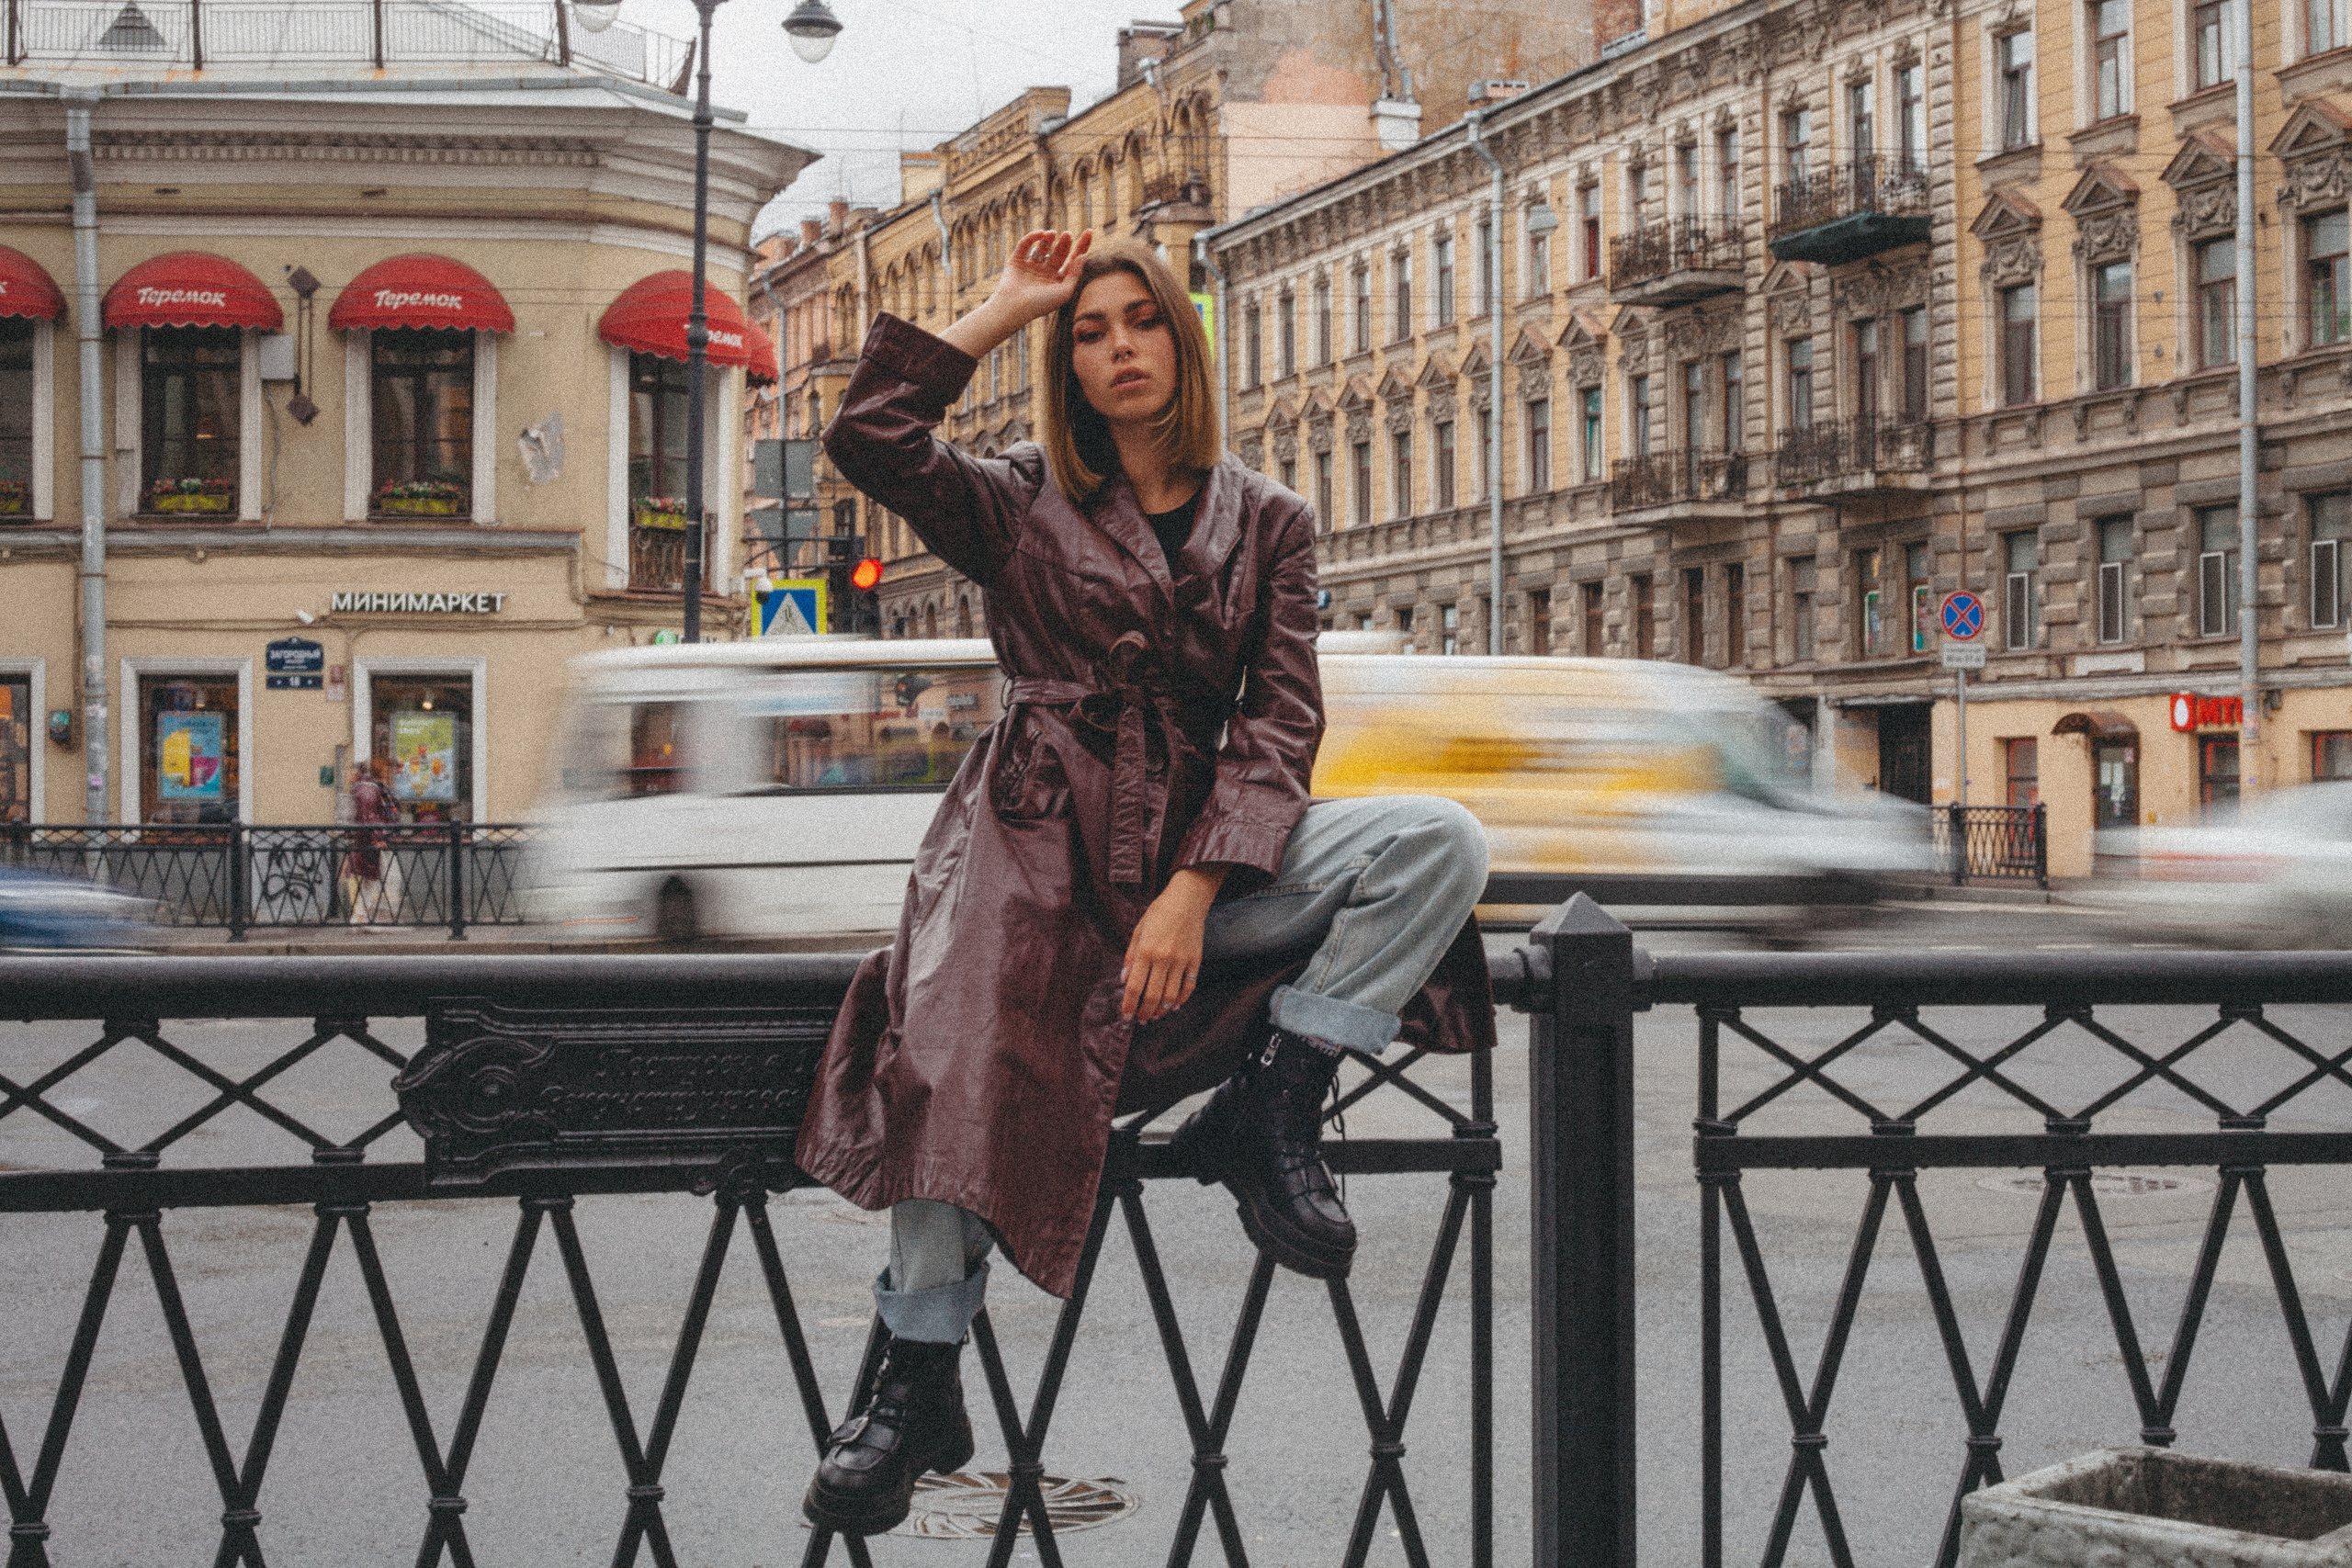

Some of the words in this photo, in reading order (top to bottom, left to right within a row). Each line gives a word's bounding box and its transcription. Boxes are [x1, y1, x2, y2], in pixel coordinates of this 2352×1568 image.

[137, 287, 226, 308] Теремок
[374, 288, 463, 310] Теремок
[332, 592, 505, 613] МИНИМАРКЕТ
